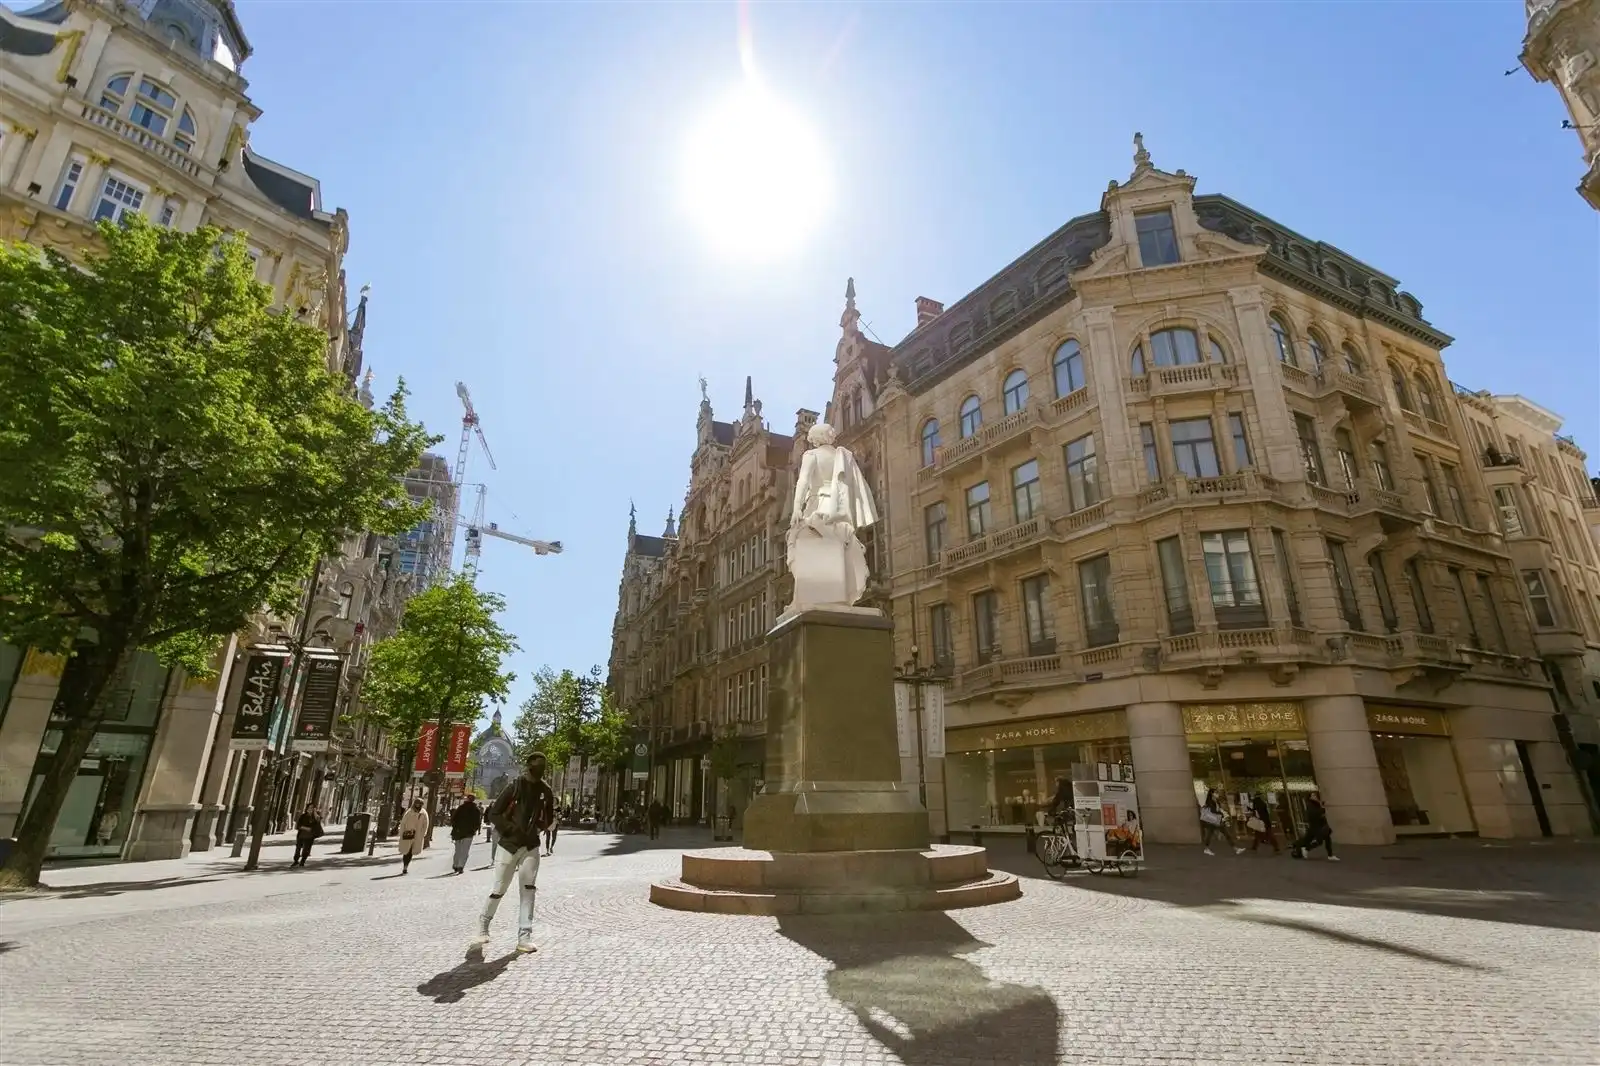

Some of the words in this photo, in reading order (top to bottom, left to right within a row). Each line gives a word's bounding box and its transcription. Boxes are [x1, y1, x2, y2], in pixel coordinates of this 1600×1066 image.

[1192, 714, 1238, 722] ZARA
[1246, 712, 1294, 721] HOME
[1376, 714, 1399, 723] ZARA
[1401, 716, 1428, 726] HOME
[995, 731, 1021, 740] ZARA
[1025, 727, 1056, 737] HOME
[454, 731, 465, 764] DAMART
